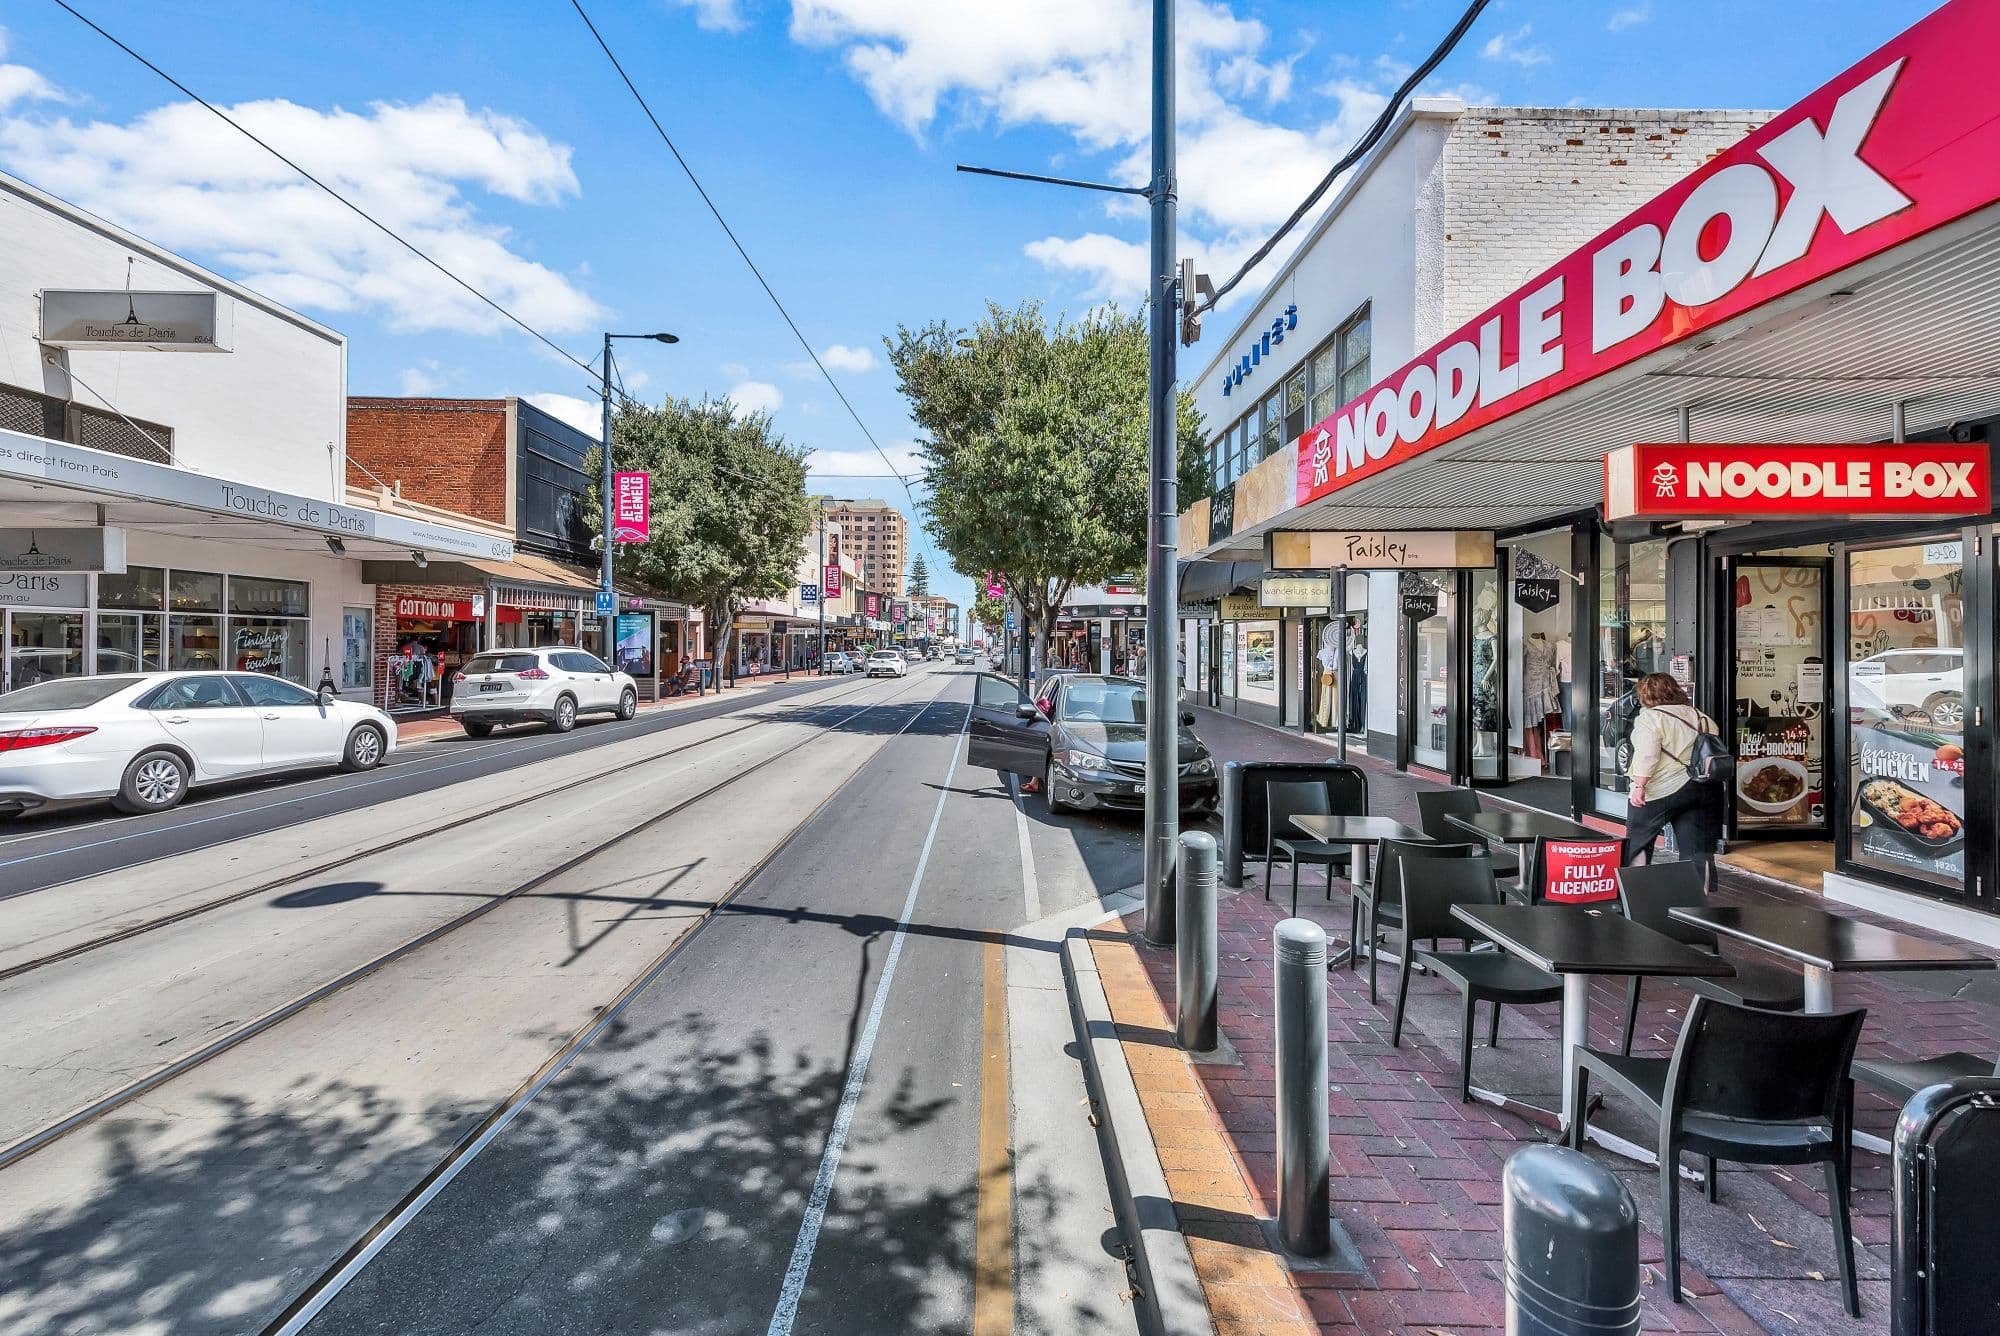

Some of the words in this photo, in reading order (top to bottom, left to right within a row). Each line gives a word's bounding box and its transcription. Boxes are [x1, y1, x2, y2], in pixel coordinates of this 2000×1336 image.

[1336, 274, 1564, 477] NOODLE
[1592, 56, 1914, 355] BOX
[85, 325, 125, 338] Touche
[129, 325, 144, 338] de
[148, 327, 176, 338] Paris
[17, 451, 56, 466] direct
[60, 459, 89, 473] from
[92, 465, 119, 479] Paris
[1686, 461, 1872, 498] NOODLE
[1884, 461, 1978, 498] BOX
[221, 485, 288, 518] Touche
[297, 503, 320, 523] de
[328, 508, 365, 532] Paris
[631, 476, 644, 523] GLENELG
[1344, 535, 1407, 566] Paisley
[0, 556, 28, 567] ouche
[32, 556, 45, 566] de
[48, 557, 72, 566] Paris
[1264, 586, 1308, 596] wanderlust
[1310, 586, 1329, 596] soul
[1517, 583, 1550, 602] Paisley
[400, 599, 439, 616] COTTON
[442, 603, 455, 617] ON
[1404, 599, 1431, 613] Paisley
[234, 626, 290, 655] Finishing
[245, 647, 284, 670] touches
[1786, 729, 1808, 741] 14.95
[1861, 742, 1914, 770] lemon
[1862, 756, 1930, 783] CHICKEN
[1935, 760, 1964, 772] 14.95
[1559, 846, 1598, 854] NOODLE
[1599, 845, 1616, 853] BOX
[1564, 864, 1605, 879] FULLY
[1551, 879, 1615, 895] LICENCED
